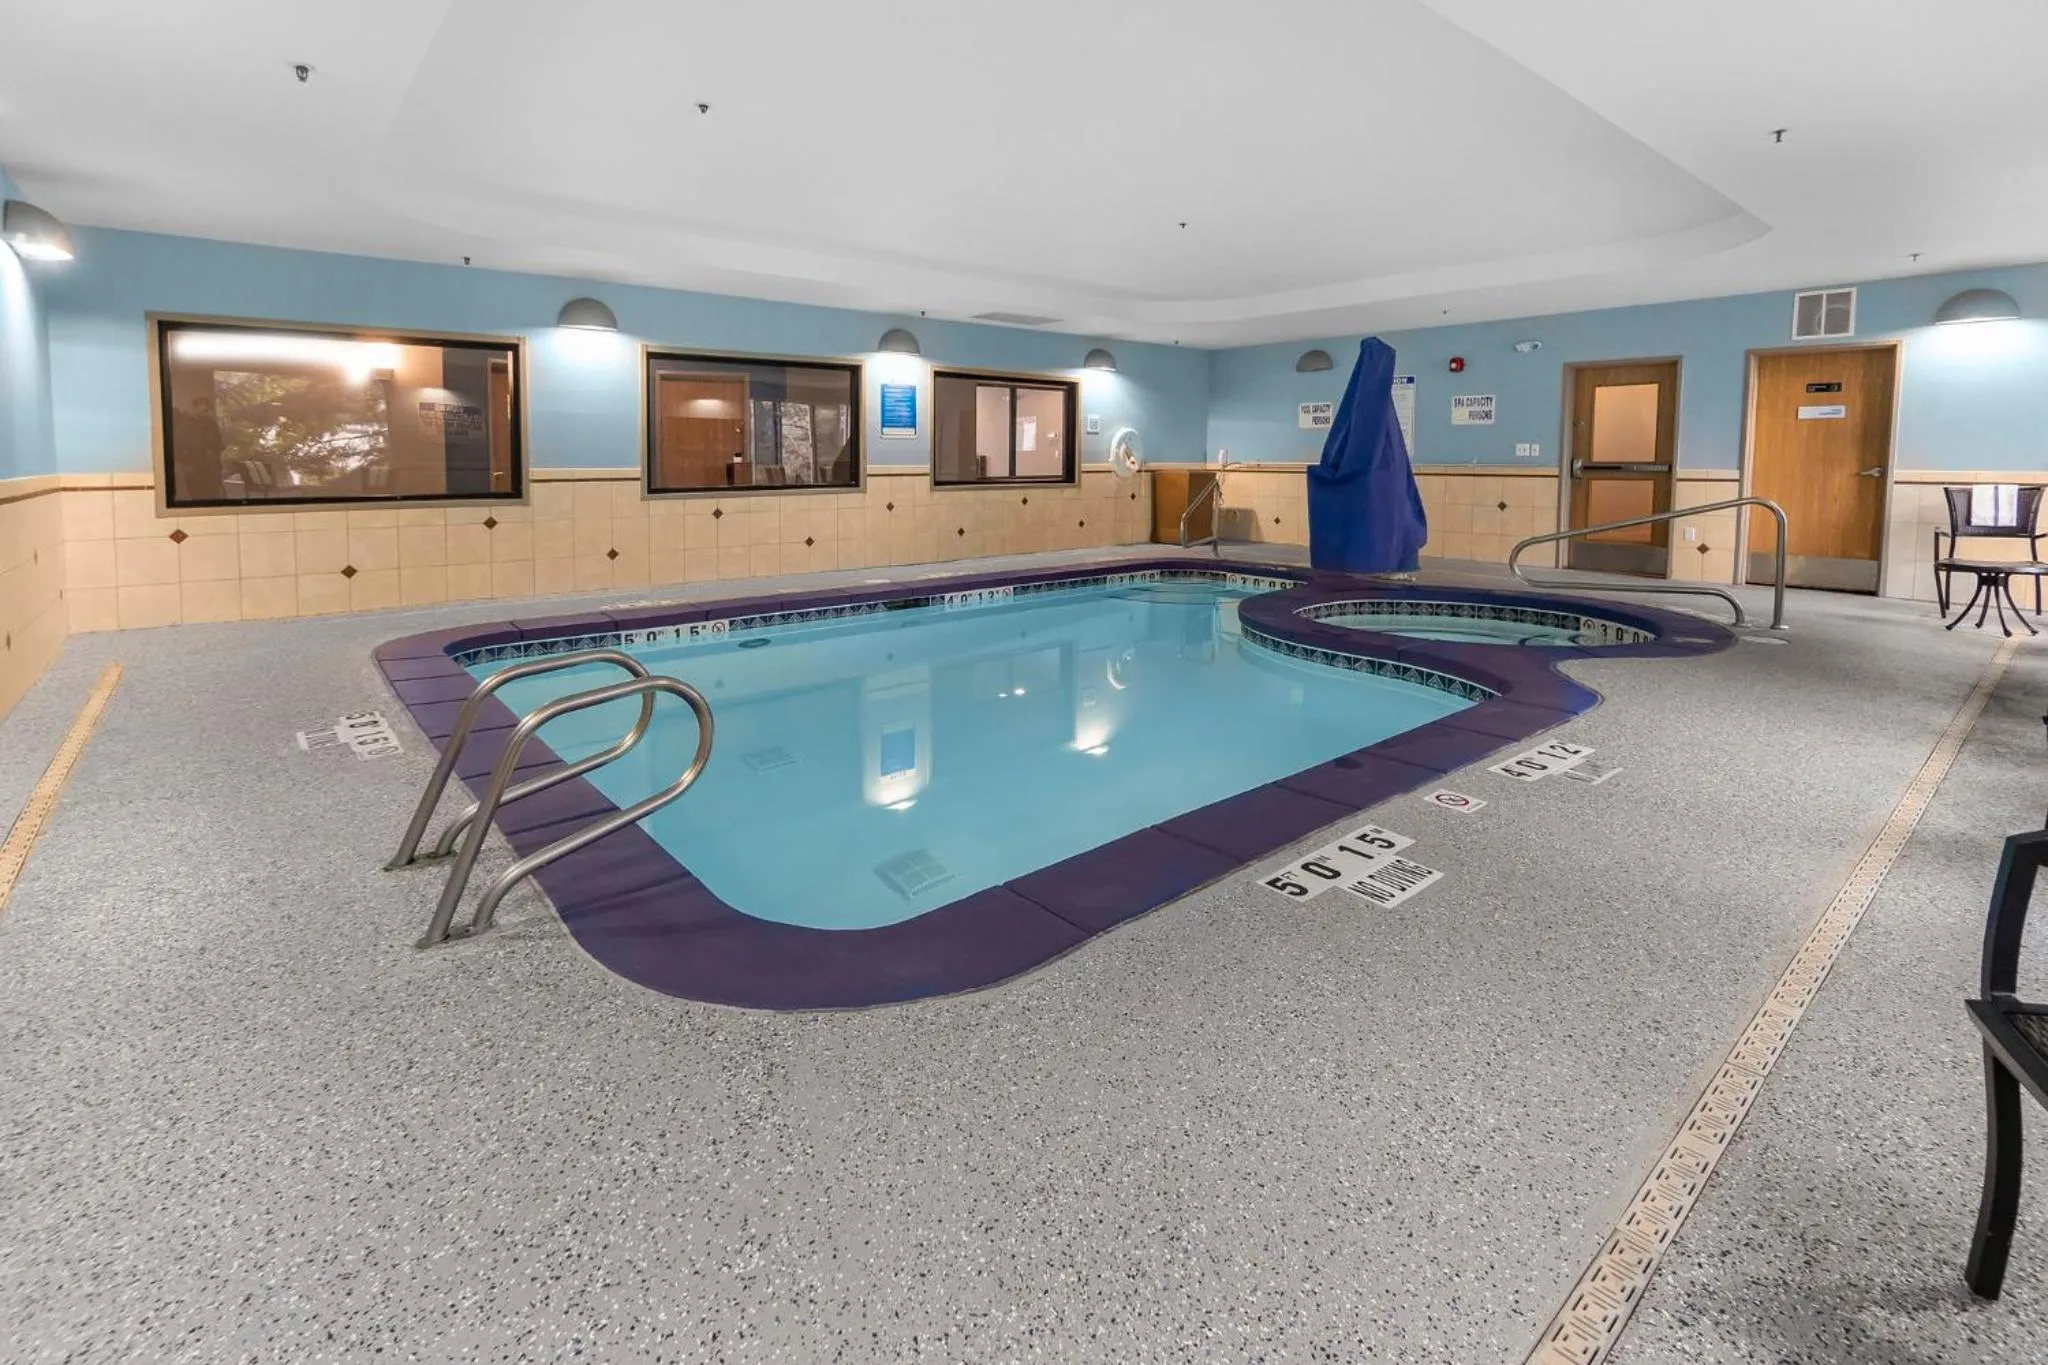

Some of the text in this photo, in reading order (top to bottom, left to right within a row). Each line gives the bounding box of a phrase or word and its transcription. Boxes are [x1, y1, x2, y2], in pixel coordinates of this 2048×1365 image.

[1454, 396, 1493, 408] SPA CAPACITY
[1312, 403, 1331, 414] CAPACITY
[1312, 416, 1331, 425] PERSONS
[1469, 410, 1493, 421] PERSONS
[1348, 859, 1433, 905] NO DIVING
